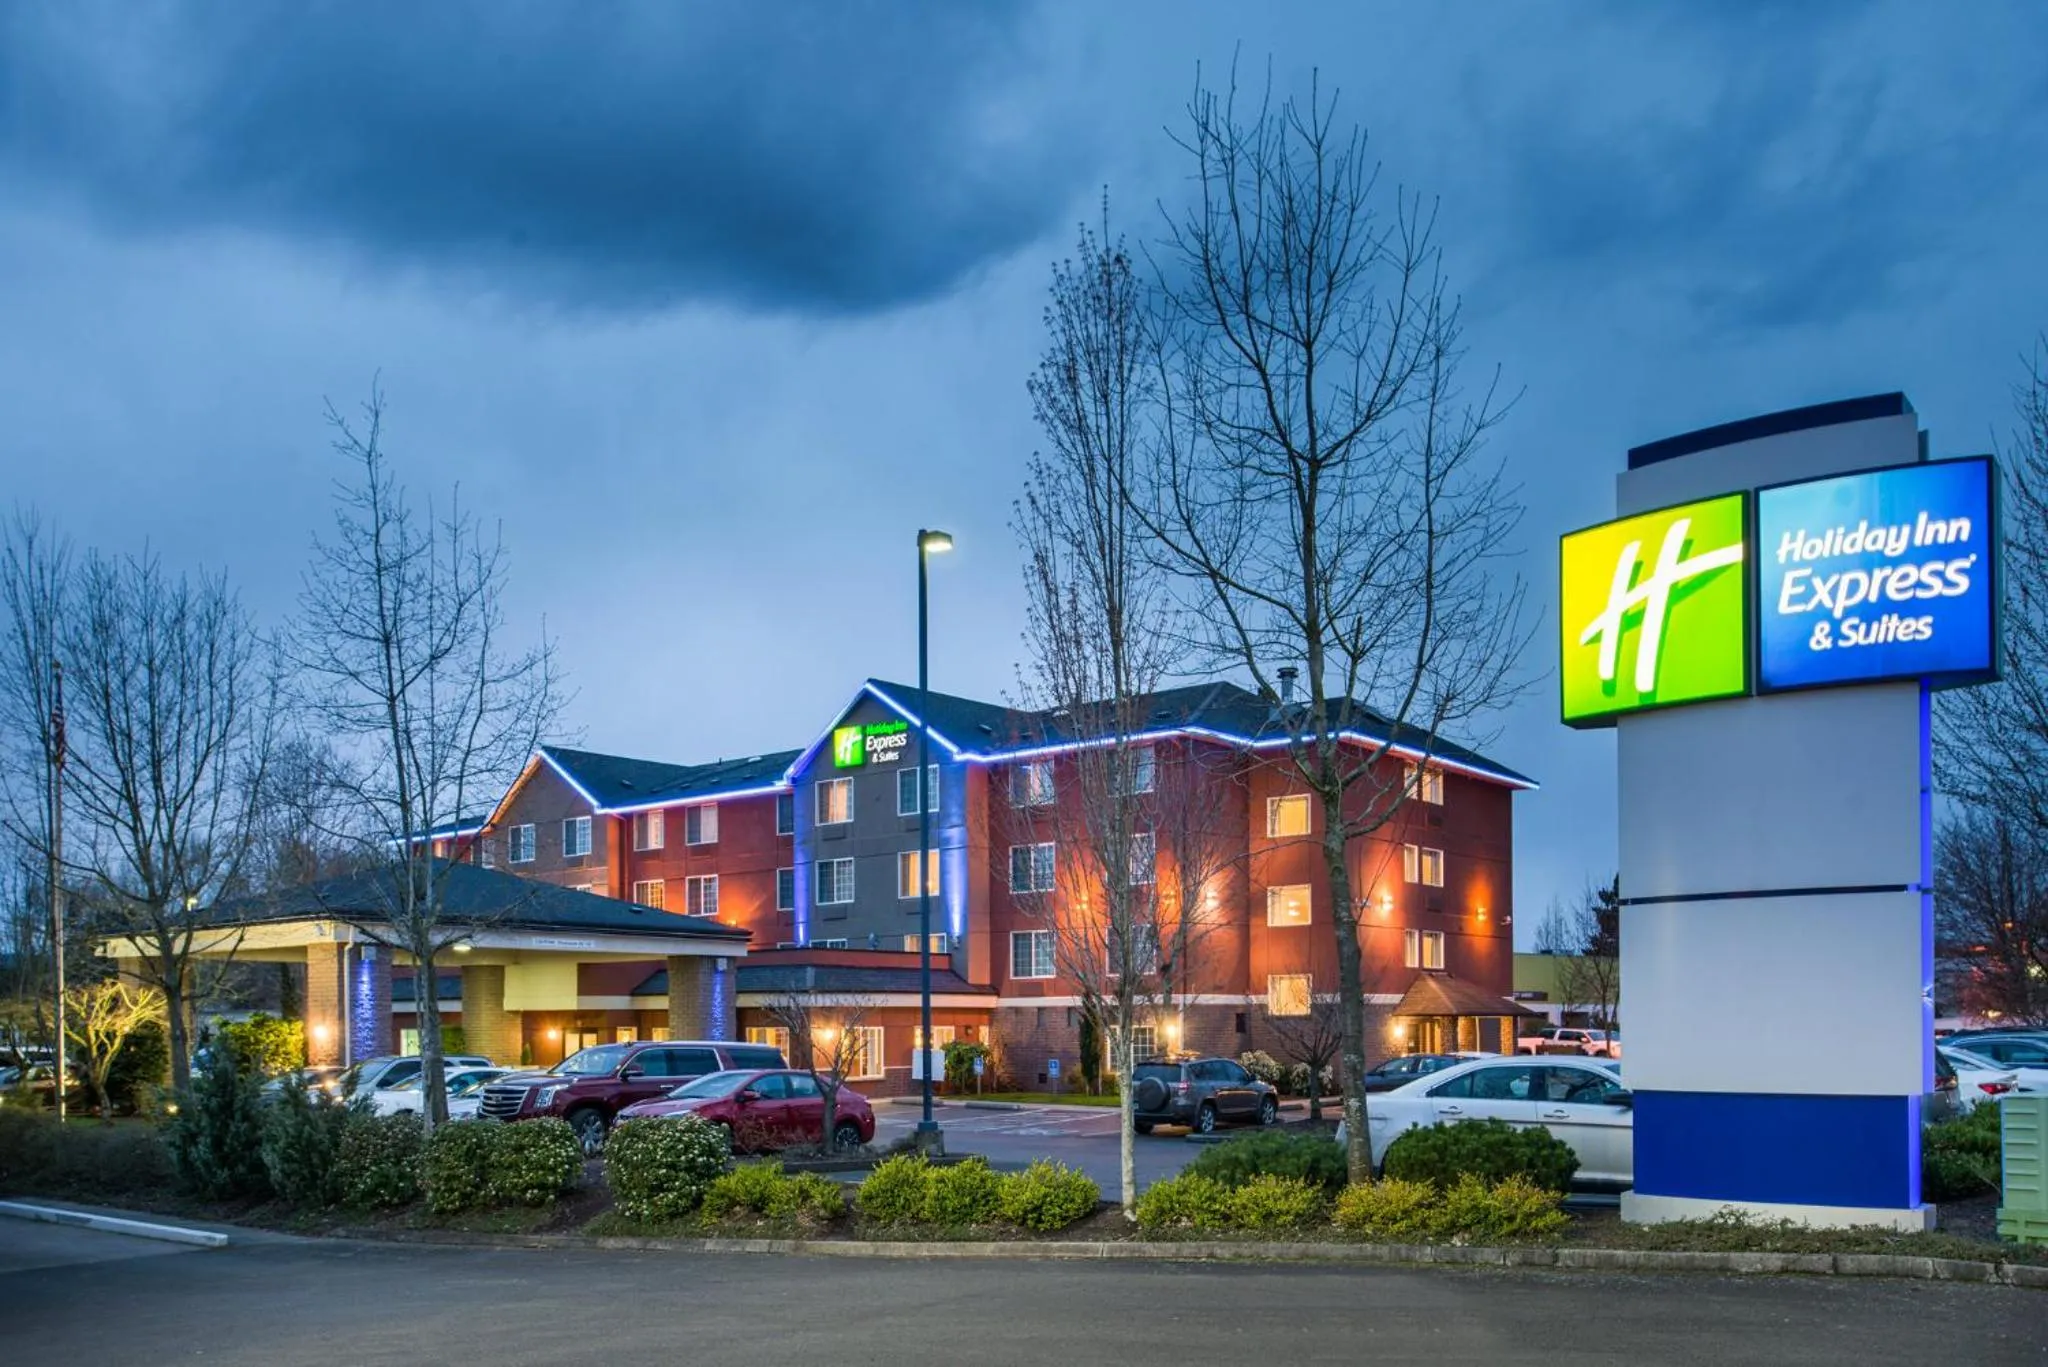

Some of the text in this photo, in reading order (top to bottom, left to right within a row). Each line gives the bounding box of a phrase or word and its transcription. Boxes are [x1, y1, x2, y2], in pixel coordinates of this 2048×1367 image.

[1776, 511, 1971, 564] Holiday Inn
[1777, 556, 1972, 620] Express
[1808, 612, 1934, 651] & Suites
[865, 733, 907, 752] Express
[879, 752, 899, 762] Suites
